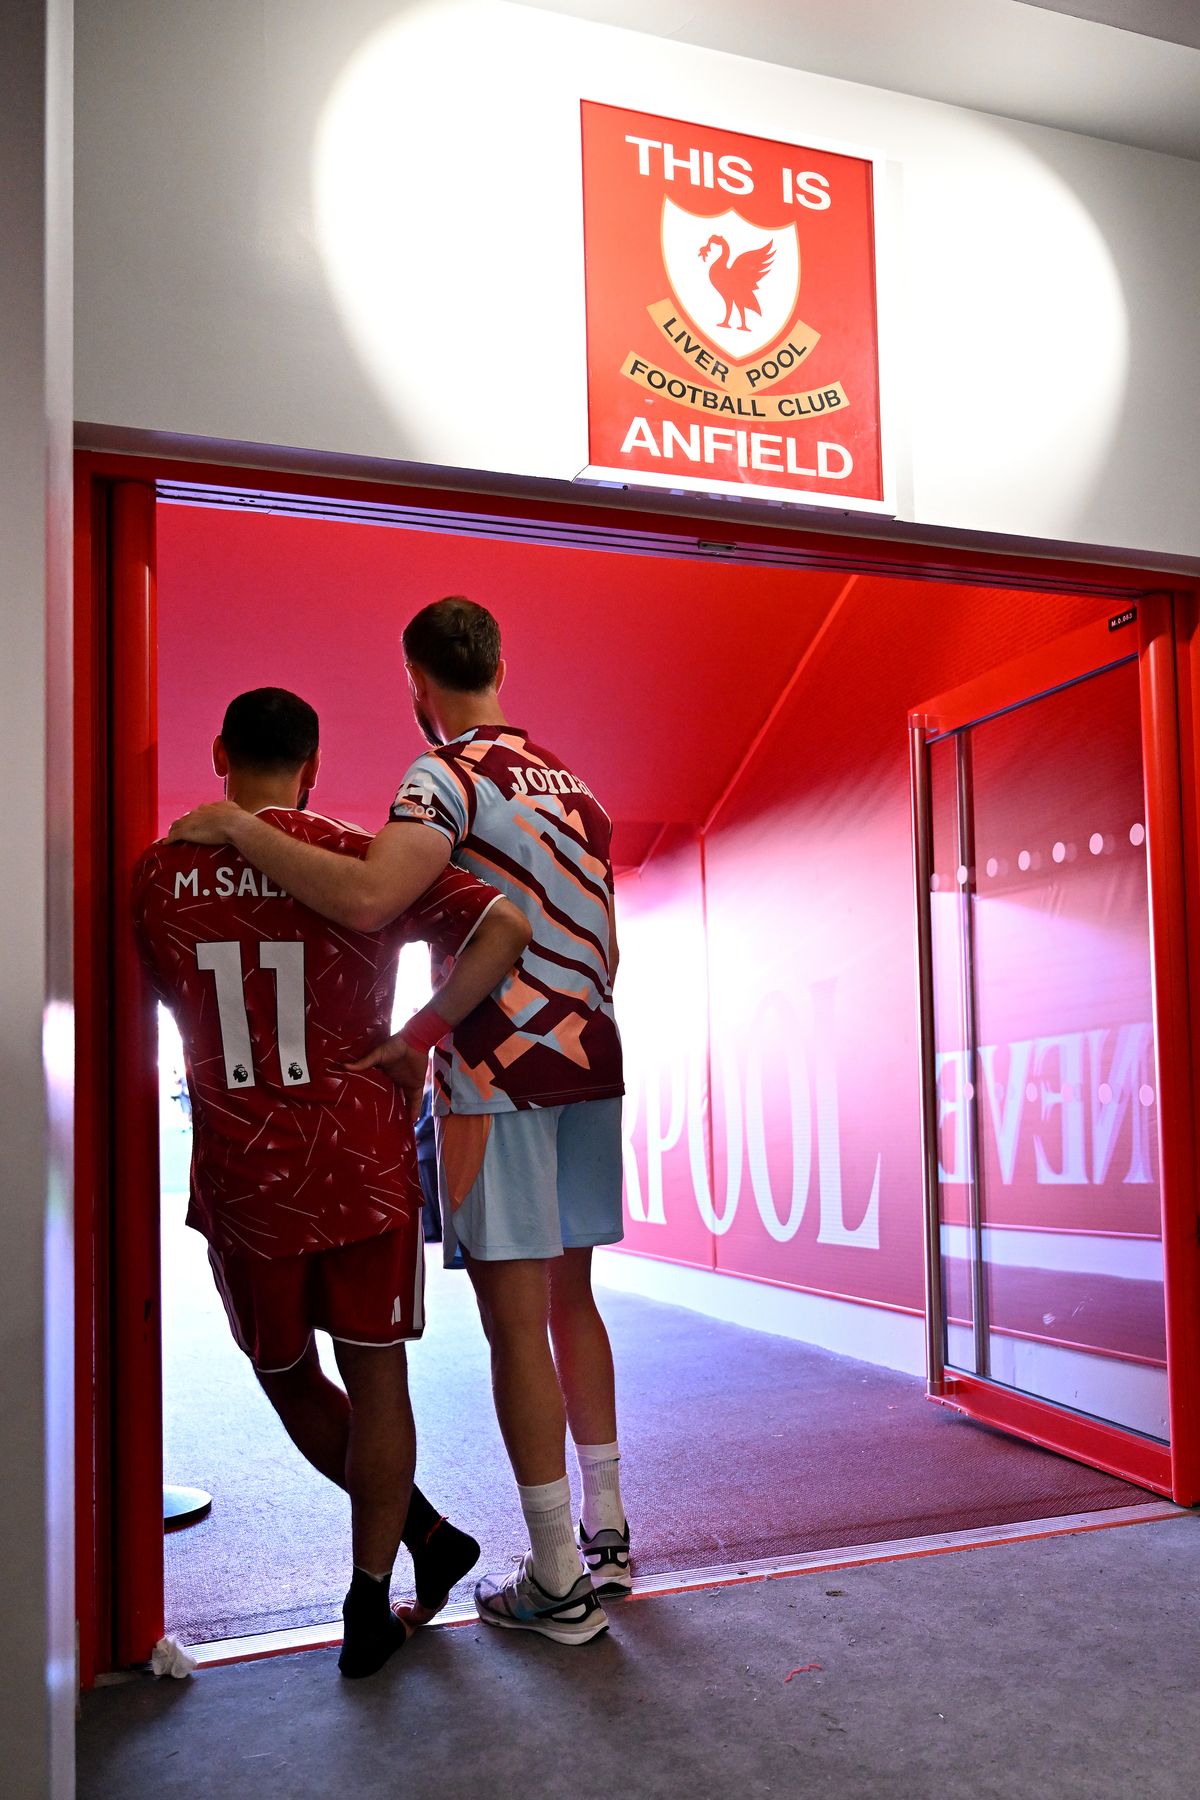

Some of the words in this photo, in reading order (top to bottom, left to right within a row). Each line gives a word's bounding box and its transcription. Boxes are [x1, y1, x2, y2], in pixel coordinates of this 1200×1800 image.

[625, 135, 754, 195] THIS
[783, 167, 832, 211] IS
[662, 317, 729, 383] LIVER
[745, 342, 807, 388] POOL
[629, 359, 766, 418] FOOTBALL
[778, 389, 842, 417] CLUB
[620, 416, 854, 480] ANFIELD
[195, 941, 311, 1089] 11
